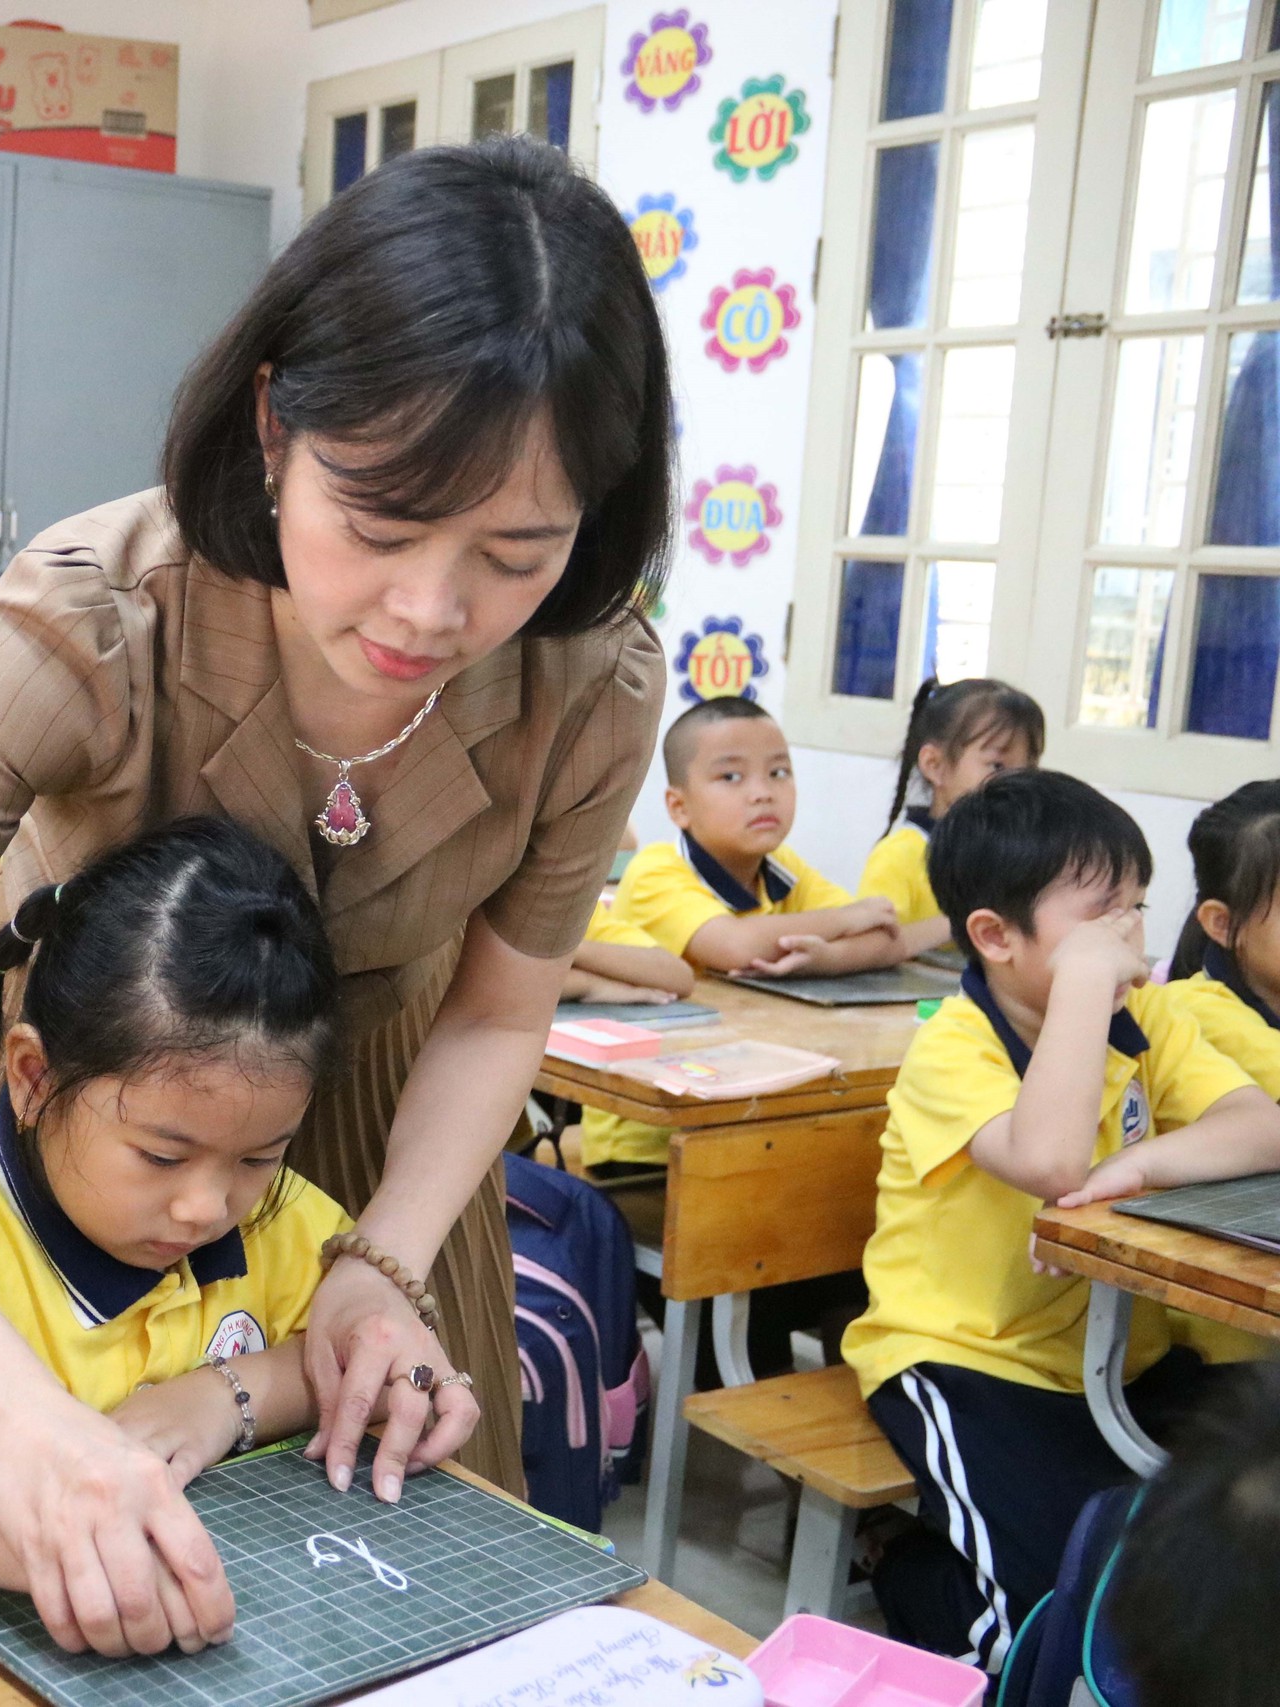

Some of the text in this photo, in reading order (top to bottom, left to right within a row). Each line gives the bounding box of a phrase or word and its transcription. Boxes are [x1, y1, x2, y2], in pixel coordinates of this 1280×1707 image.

[727, 99, 788, 155] LỜI
[722, 291, 771, 344] CÔ
[703, 499, 764, 533] ĐUA
[689, 631, 750, 688] TỐT
